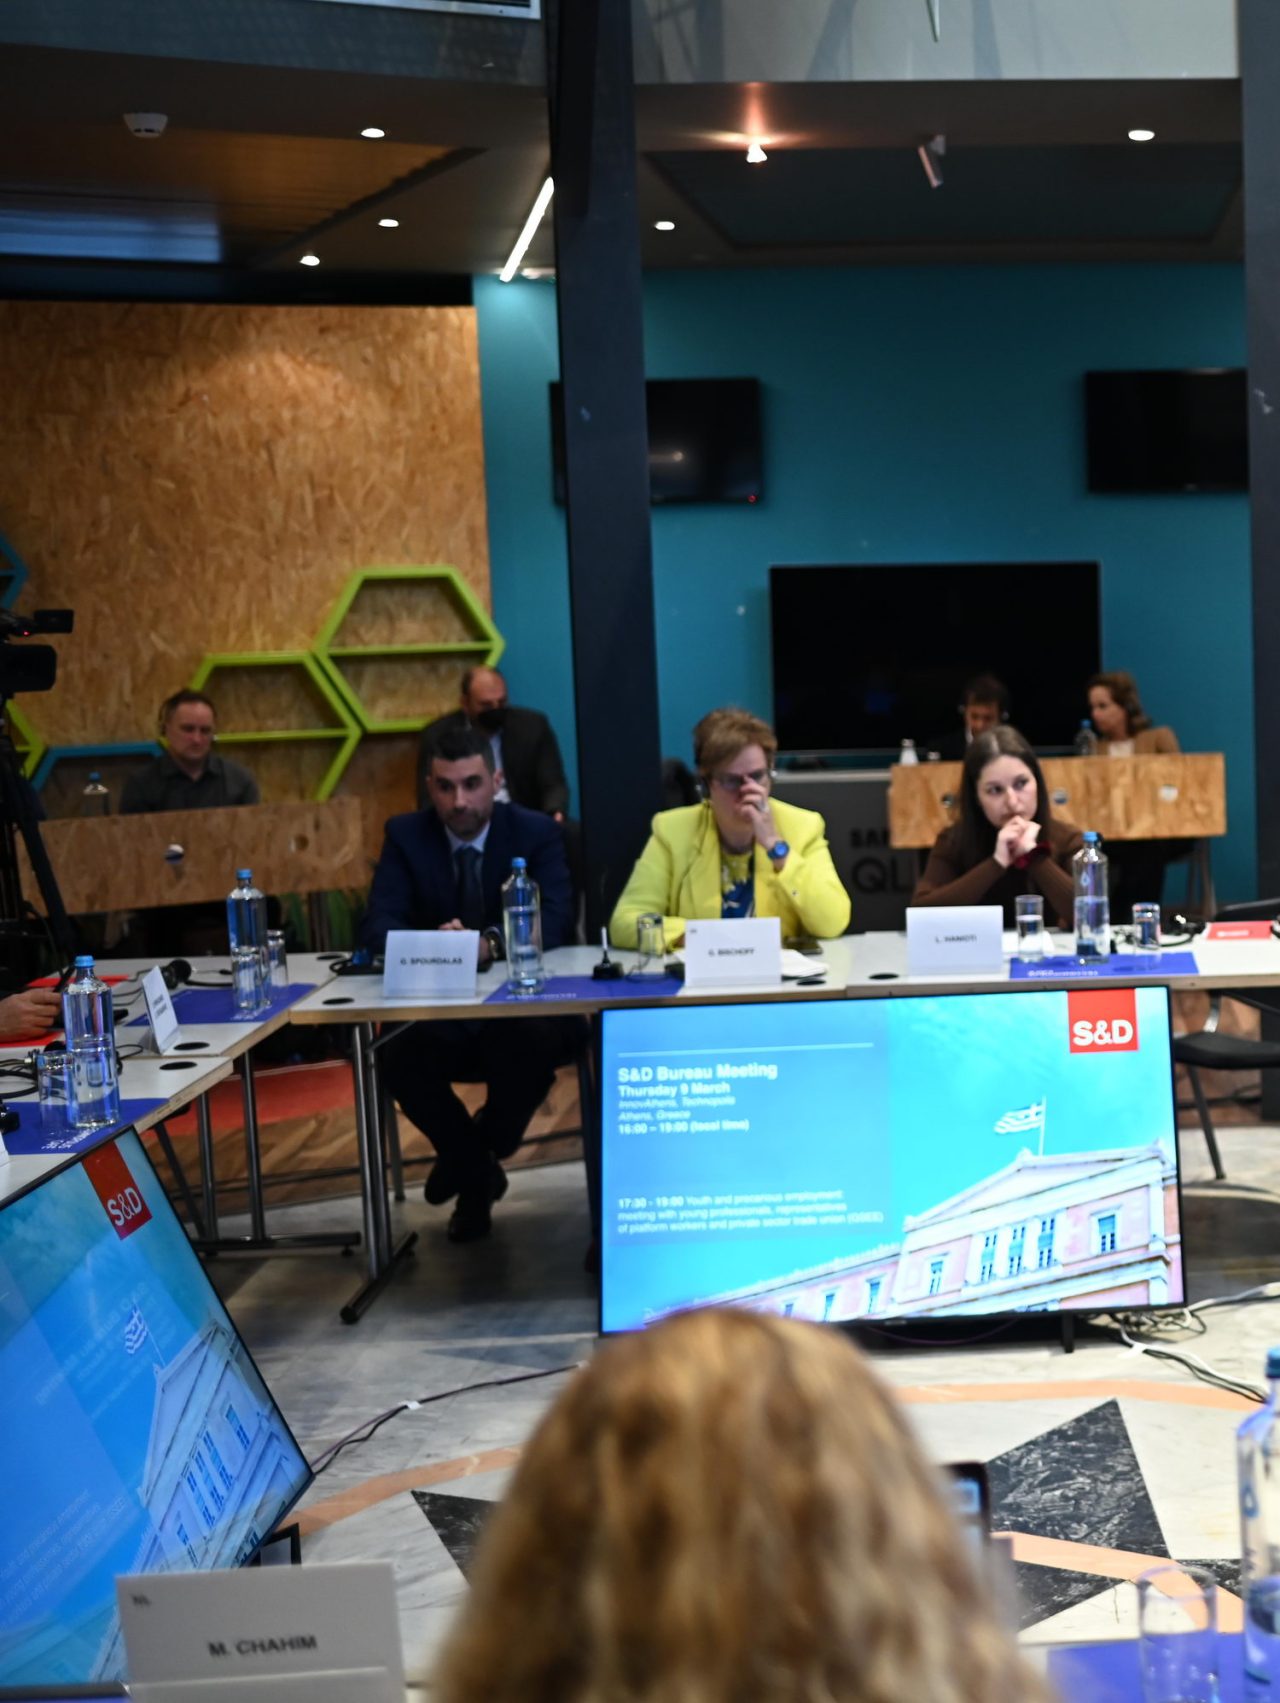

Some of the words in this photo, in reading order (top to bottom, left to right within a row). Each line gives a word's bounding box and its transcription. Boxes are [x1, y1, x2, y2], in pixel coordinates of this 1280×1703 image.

[1072, 1019, 1133, 1046] S&D
[618, 1067, 653, 1083] S&D
[656, 1065, 713, 1081] Bureau
[716, 1062, 778, 1080] Meeting
[618, 1084, 677, 1098] Thursday
[691, 1081, 730, 1095] March
[618, 1123, 648, 1135] 16:00
[107, 1186, 143, 1226] S&D
[207, 1641, 229, 1657] M.
[235, 1634, 318, 1656] CHAHIM
